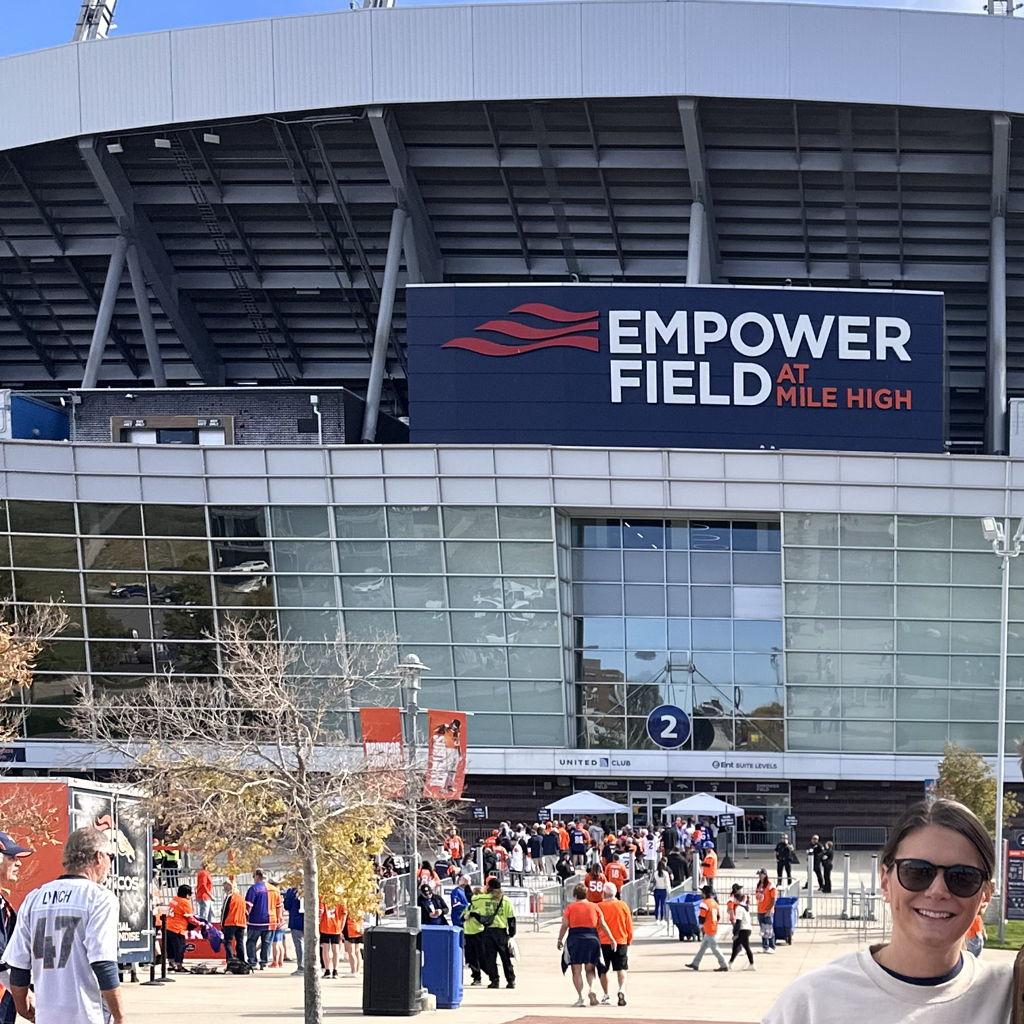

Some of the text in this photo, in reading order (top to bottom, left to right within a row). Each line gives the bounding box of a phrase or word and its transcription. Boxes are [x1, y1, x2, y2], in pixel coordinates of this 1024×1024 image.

[609, 310, 912, 361] EMPOWER
[610, 360, 772, 406] FIELD
[776, 363, 810, 384] AT
[776, 386, 912, 410] MILE HIGH
[660, 715, 678, 739] 2
[42, 889, 73, 905] LYNCH
[589, 881, 603, 892] 58
[32, 915, 83, 970] 47
